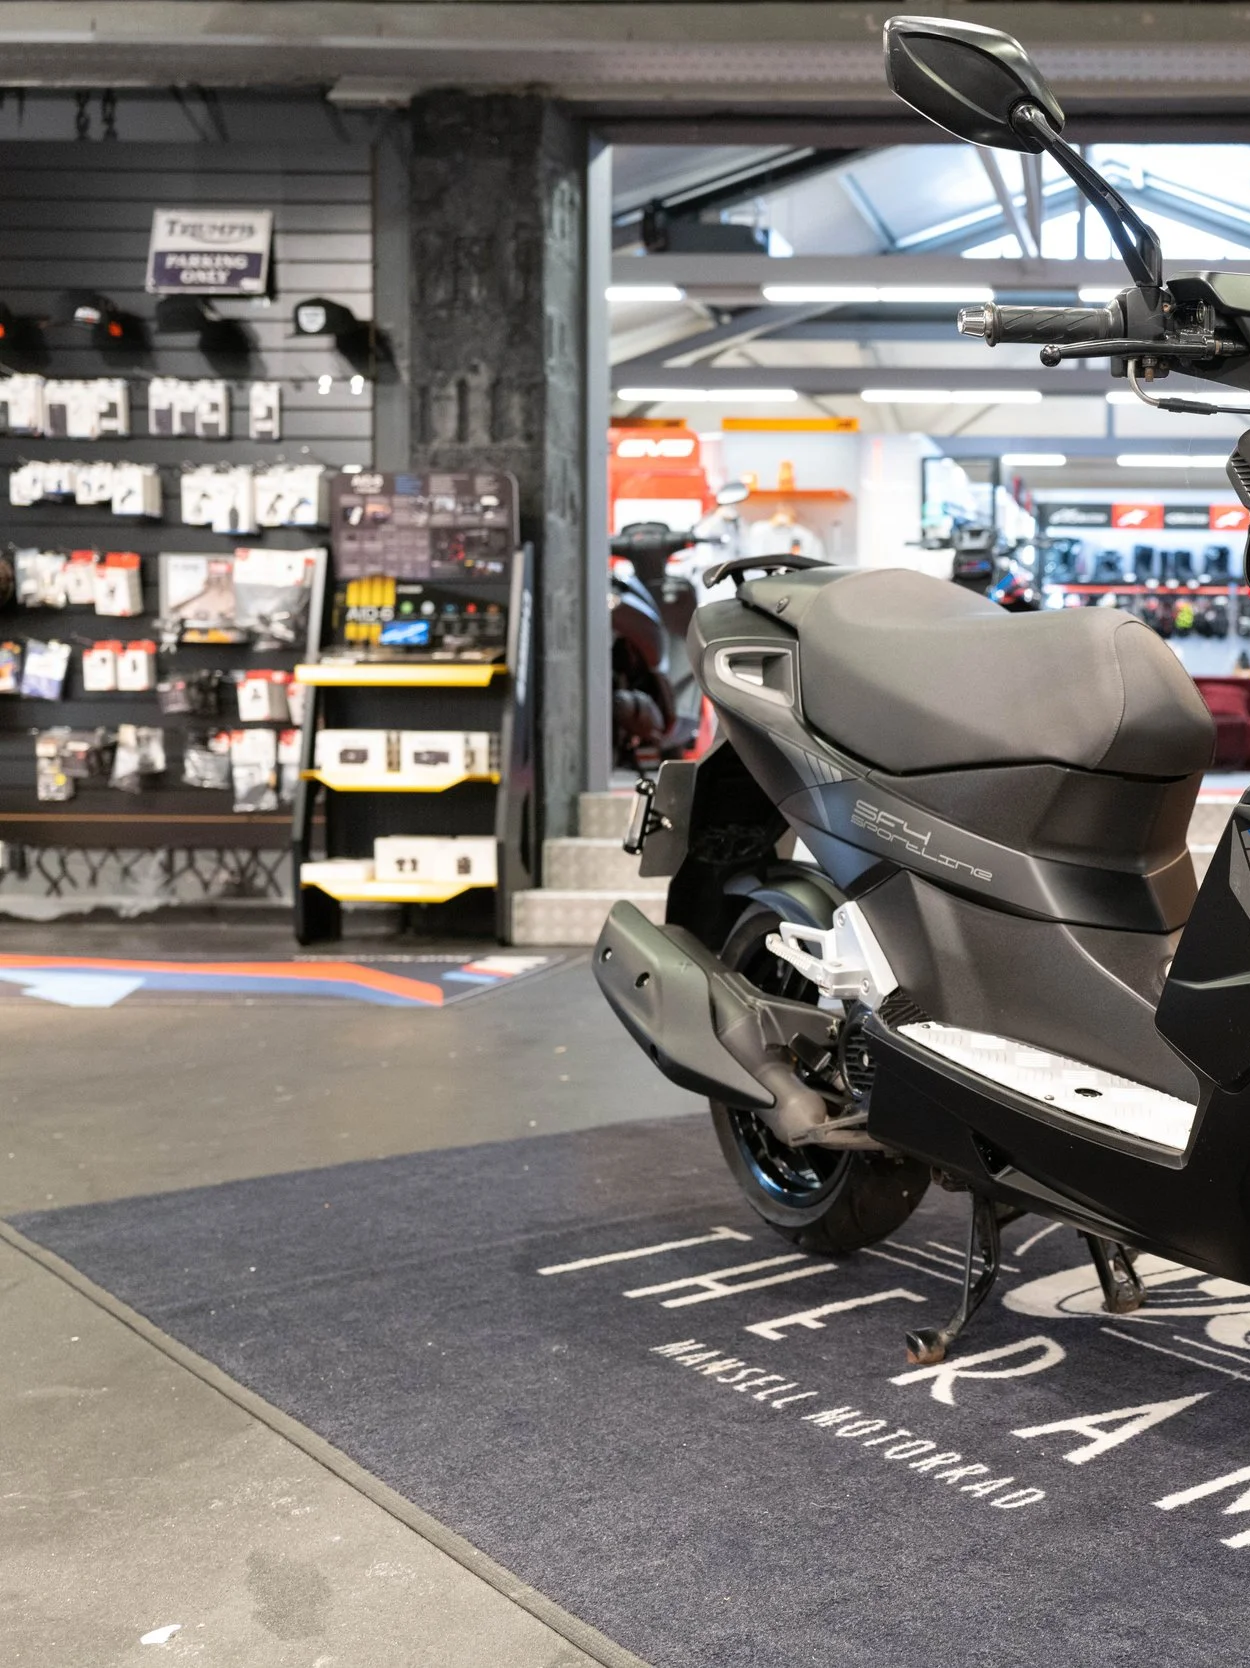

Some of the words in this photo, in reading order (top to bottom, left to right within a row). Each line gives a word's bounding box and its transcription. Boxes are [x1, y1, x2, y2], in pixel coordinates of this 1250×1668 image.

[164, 253, 249, 270] PARKING
[179, 269, 231, 285] ONLY
[537, 1226, 927, 1341] THE
[649, 1339, 819, 1409] MANSELL
[801, 1406, 1046, 1509] MOTORRAD
